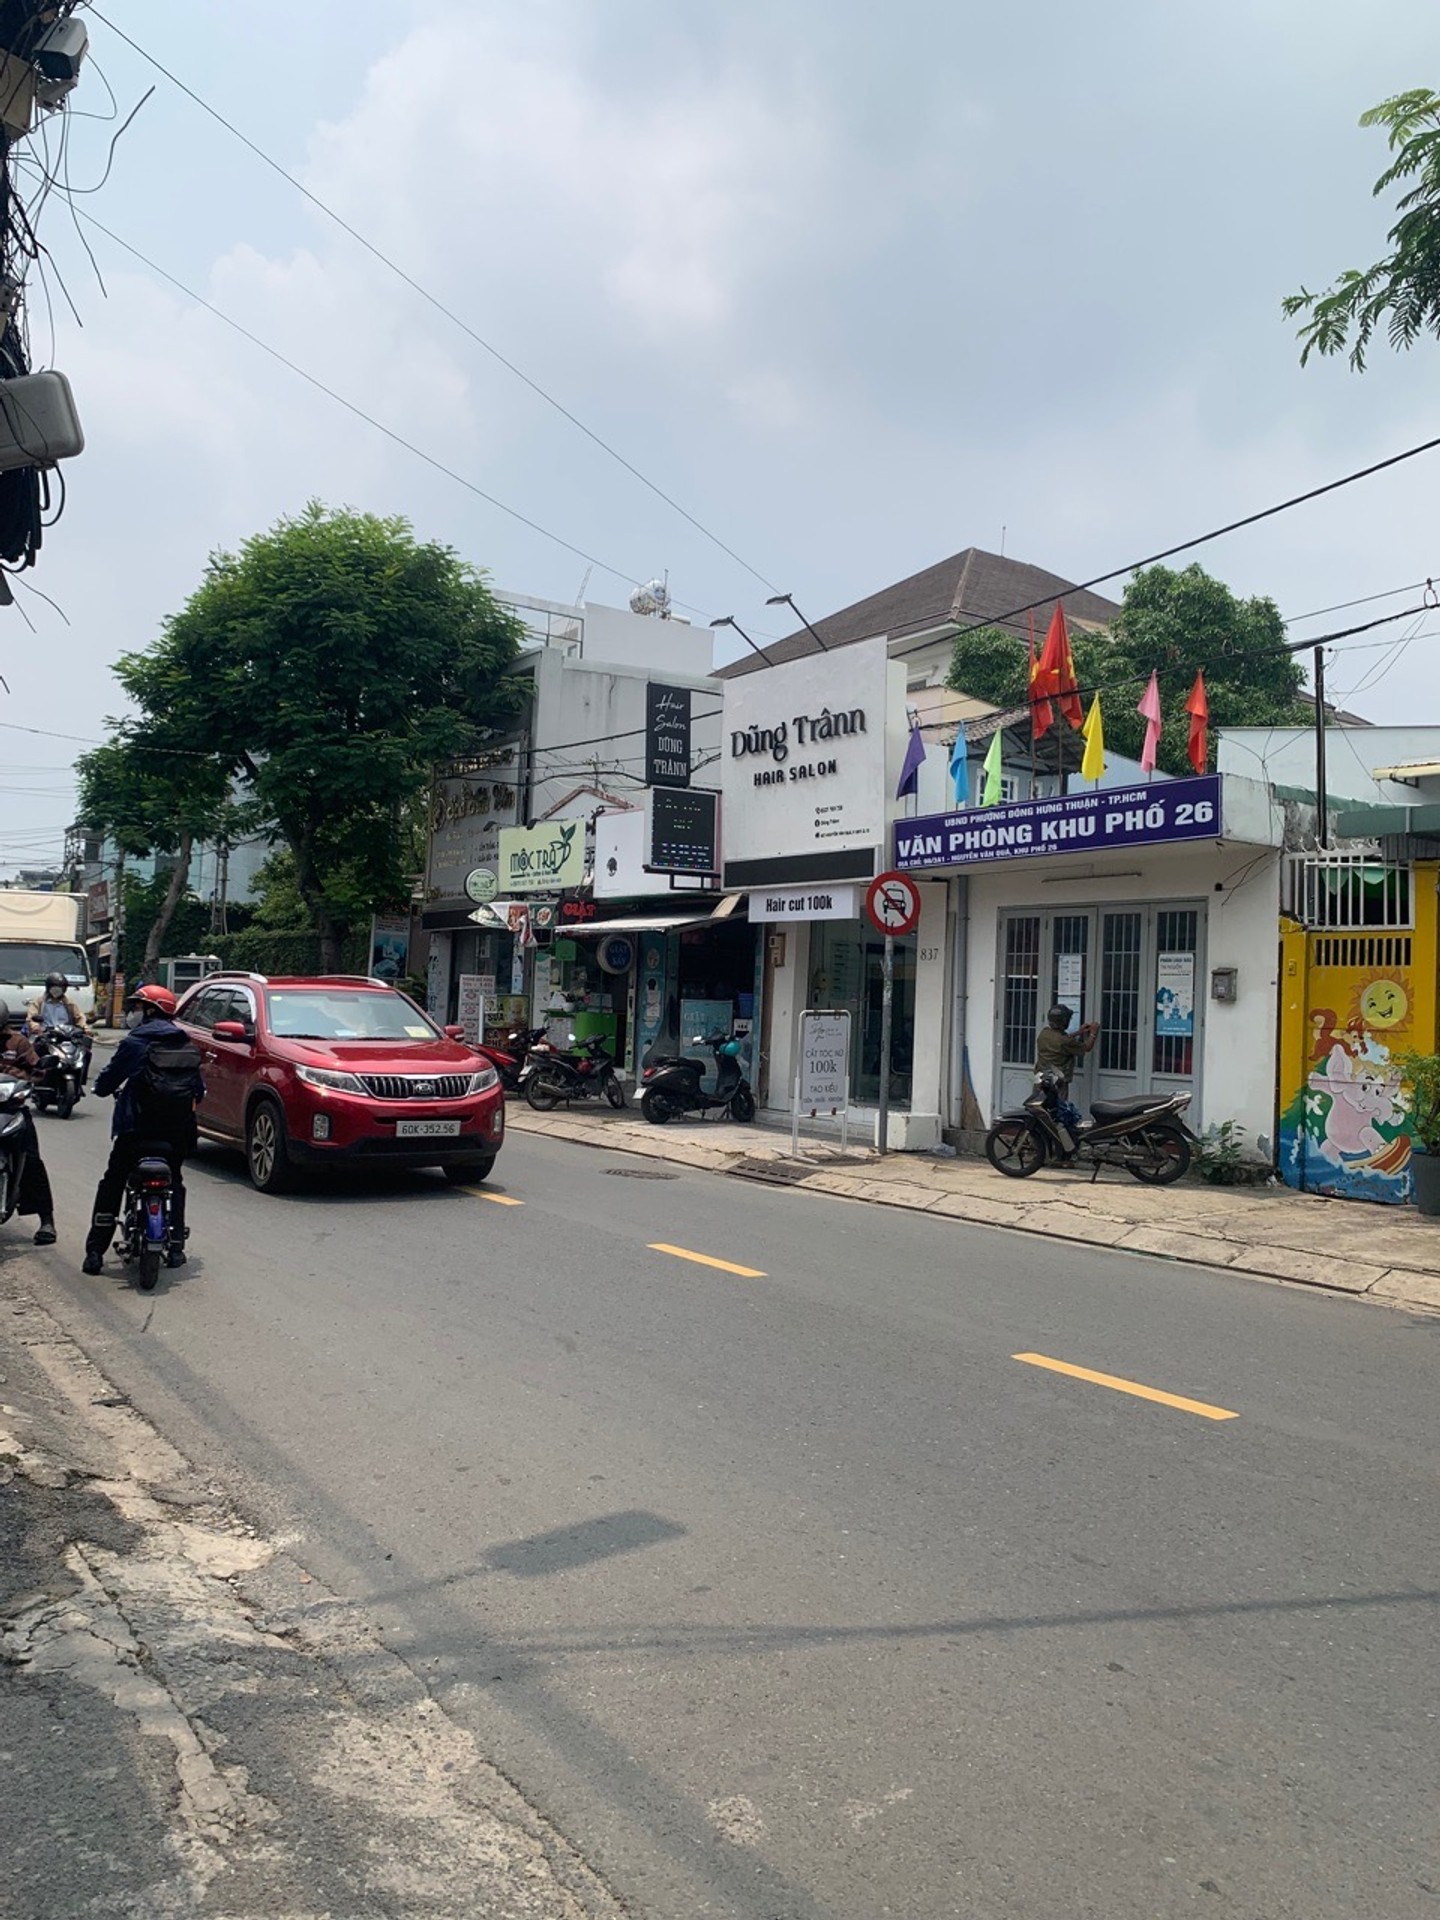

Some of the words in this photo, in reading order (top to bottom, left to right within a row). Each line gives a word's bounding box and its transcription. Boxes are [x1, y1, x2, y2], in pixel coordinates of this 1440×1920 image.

[655, 693, 685, 711] Hair
[654, 714, 686, 732] Salon
[730, 722, 788, 761] Dũng
[792, 707, 867, 744] Trânn
[653, 758, 687, 777] TRÂNN
[753, 769, 785, 786] HAIR
[789, 759, 837, 781] SALON
[945, 816, 968, 828] UBND
[970, 810, 1006, 823] PHƯỜNG
[1036, 803, 1063, 814] HƯNG
[1065, 797, 1098, 811] THUẬN
[1108, 791, 1147, 805] TP.HCM
[898, 834, 942, 858] VĂN
[949, 824, 1032, 852] PHÒNG
[1041, 816, 1096, 841] KHU
[1105, 799, 1166, 834] PHỐ
[1174, 801, 1213, 826] 26
[766, 897, 786, 912] Hair
[788, 897, 805, 911] cut
[807, 894, 833, 910] 100k
[920, 947, 939, 961] 837
[810, 1059, 837, 1073] 100k
[402, 1124, 455, 1135] 60K-352.56
